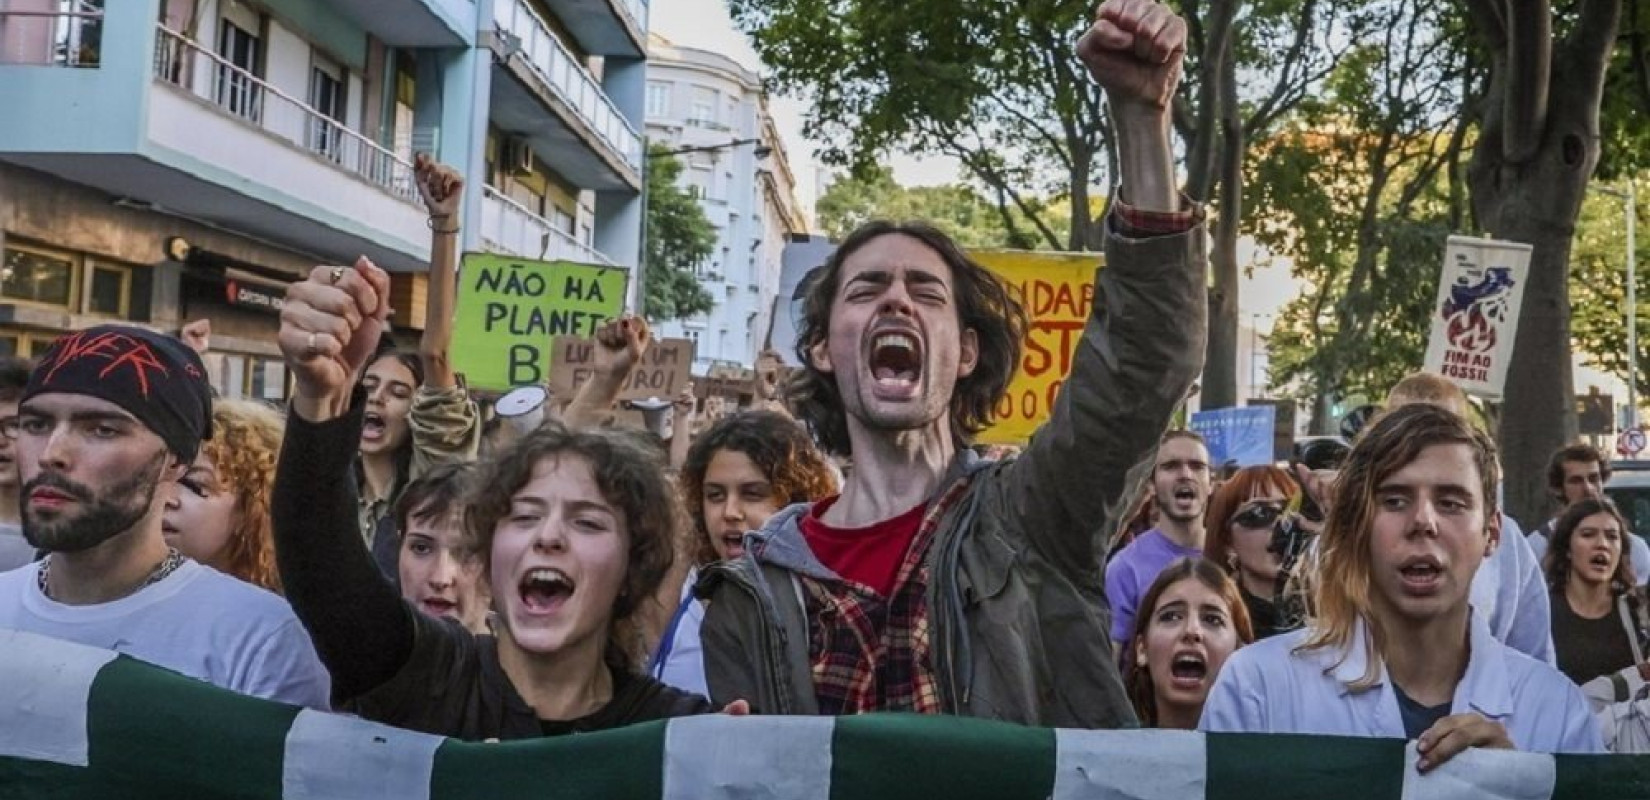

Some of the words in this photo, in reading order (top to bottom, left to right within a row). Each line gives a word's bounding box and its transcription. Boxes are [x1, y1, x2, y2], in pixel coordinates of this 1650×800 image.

[474, 264, 546, 298] NÃO
[563, 268, 605, 303] HÁ
[485, 302, 614, 338] PLANET
[508, 344, 542, 387] B
[1441, 364, 1489, 382] FOSSIL
[1444, 350, 1469, 364] FIM
[1472, 354, 1491, 368] AO
